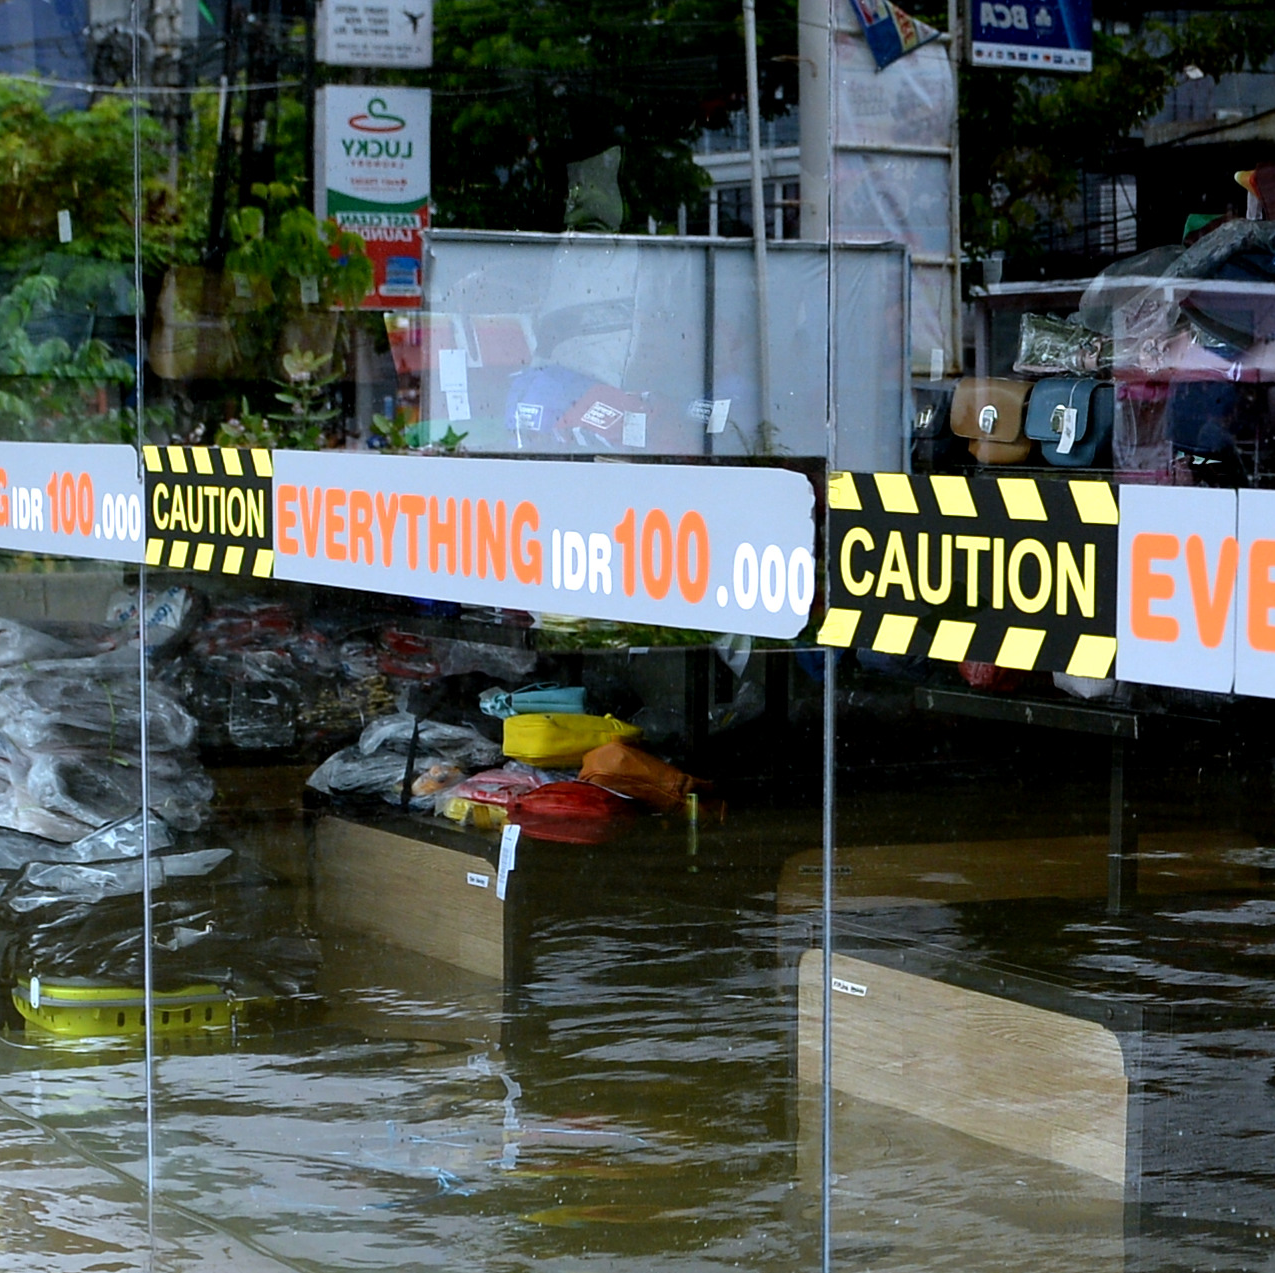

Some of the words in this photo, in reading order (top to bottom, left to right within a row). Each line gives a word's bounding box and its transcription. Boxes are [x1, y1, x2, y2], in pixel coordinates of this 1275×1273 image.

[12, 486, 44, 532] IDR
[153, 483, 265, 539] CAUTION
[277, 484, 543, 586] EVERYTHING
[551, 528, 613, 595] IDR
[838, 526, 1096, 618] CAUTION
